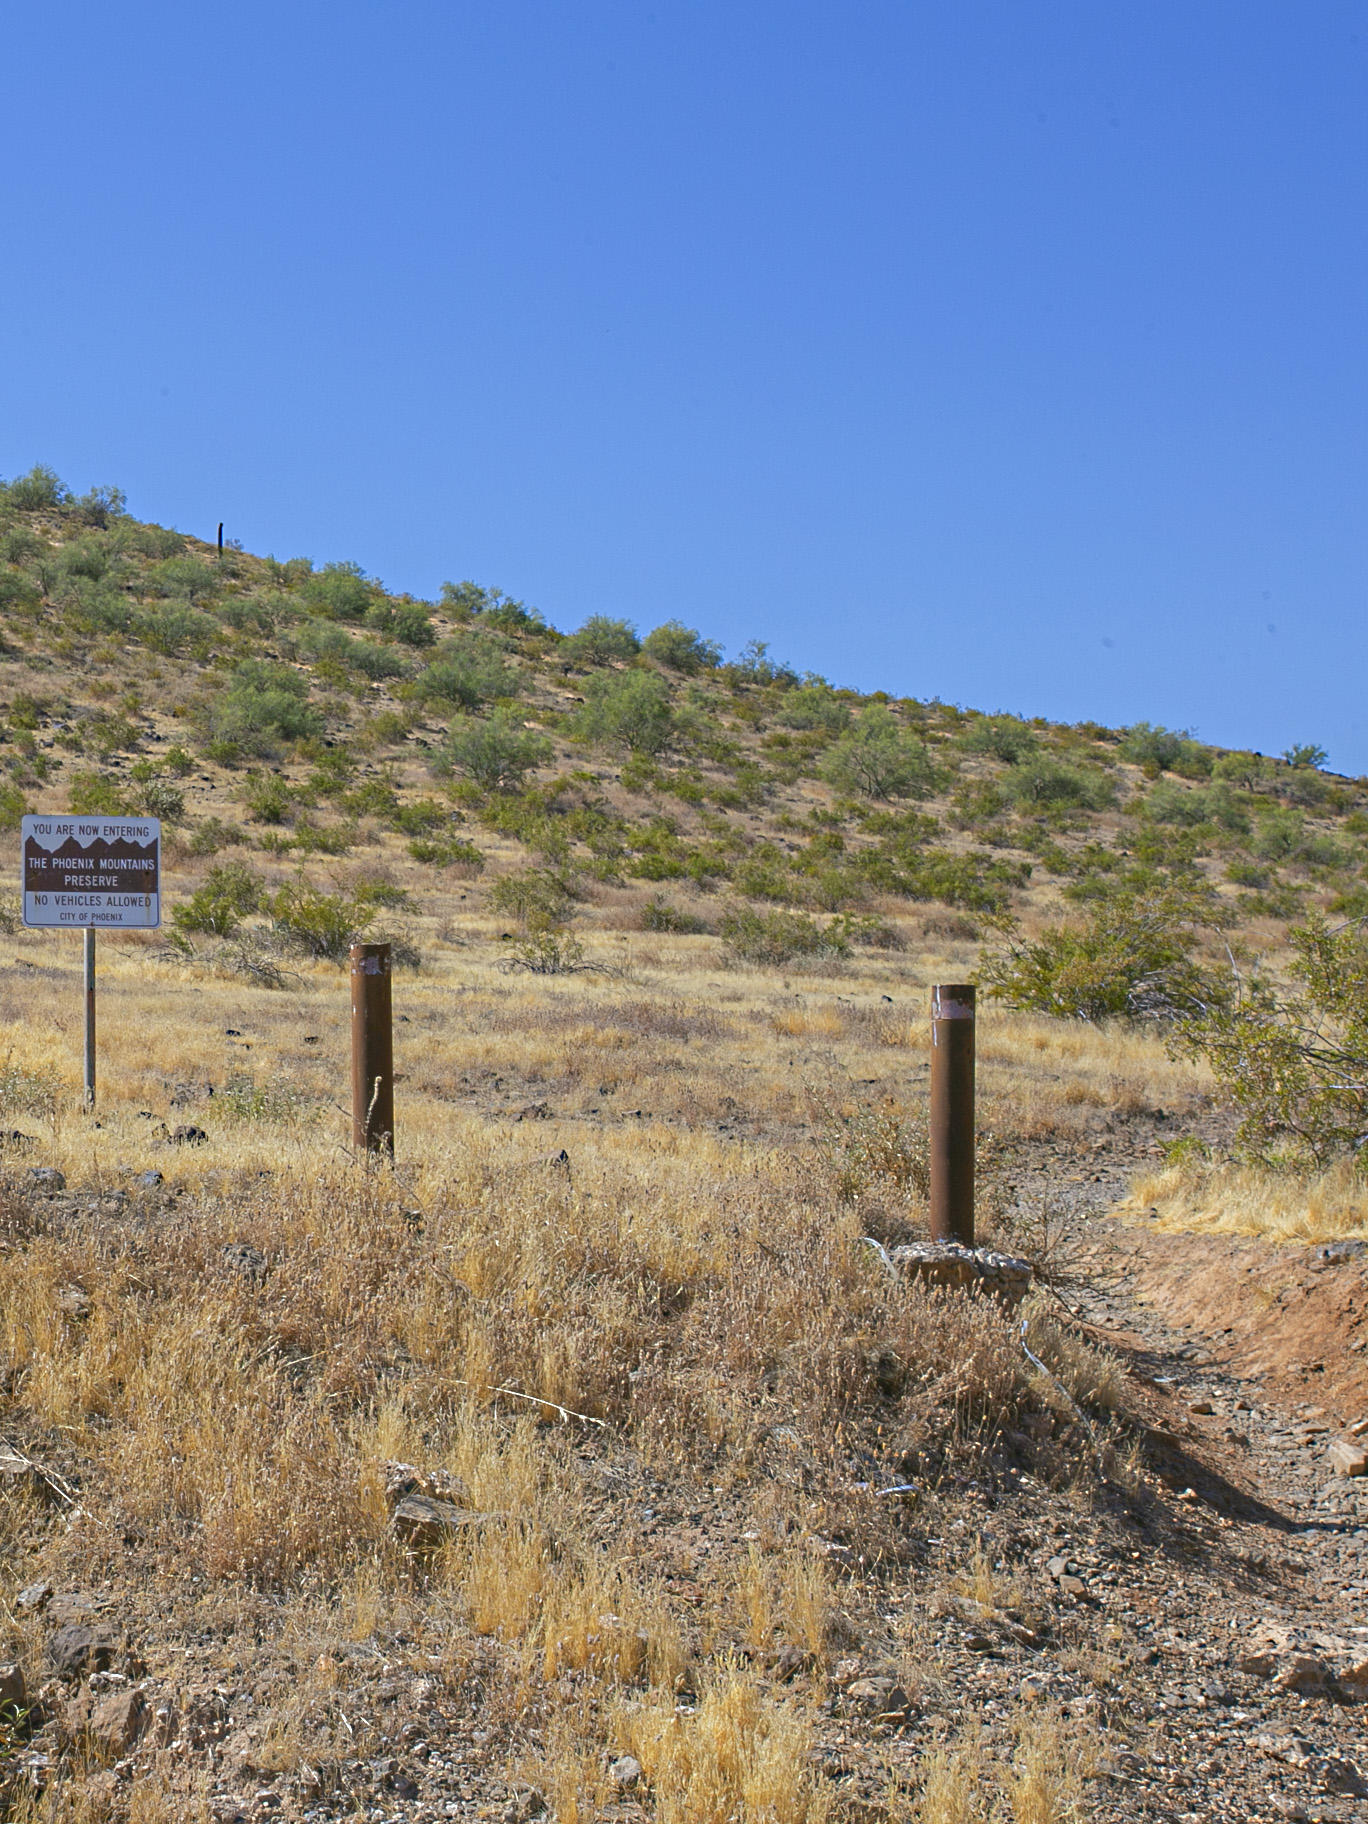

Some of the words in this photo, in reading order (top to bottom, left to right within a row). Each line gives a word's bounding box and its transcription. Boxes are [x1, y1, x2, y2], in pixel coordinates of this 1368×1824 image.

[33, 824, 52, 834] YOU
[56, 825, 74, 835] ARE
[79, 825, 99, 836] NOW
[103, 826, 150, 837] ENTERING
[29, 857, 47, 868] THE
[52, 858, 94, 869] PHOENIX
[100, 859, 155, 870] MOUNTAINS
[64, 875, 118, 886] PRESERVE
[34, 895, 48, 905] NO
[55, 895, 101, 906] VEHICLES
[107, 896, 151, 907] ALLOWED
[60, 912, 75, 921] CITY
[79, 913, 88, 921] OF
[92, 913, 123, 921] PHOENIX
